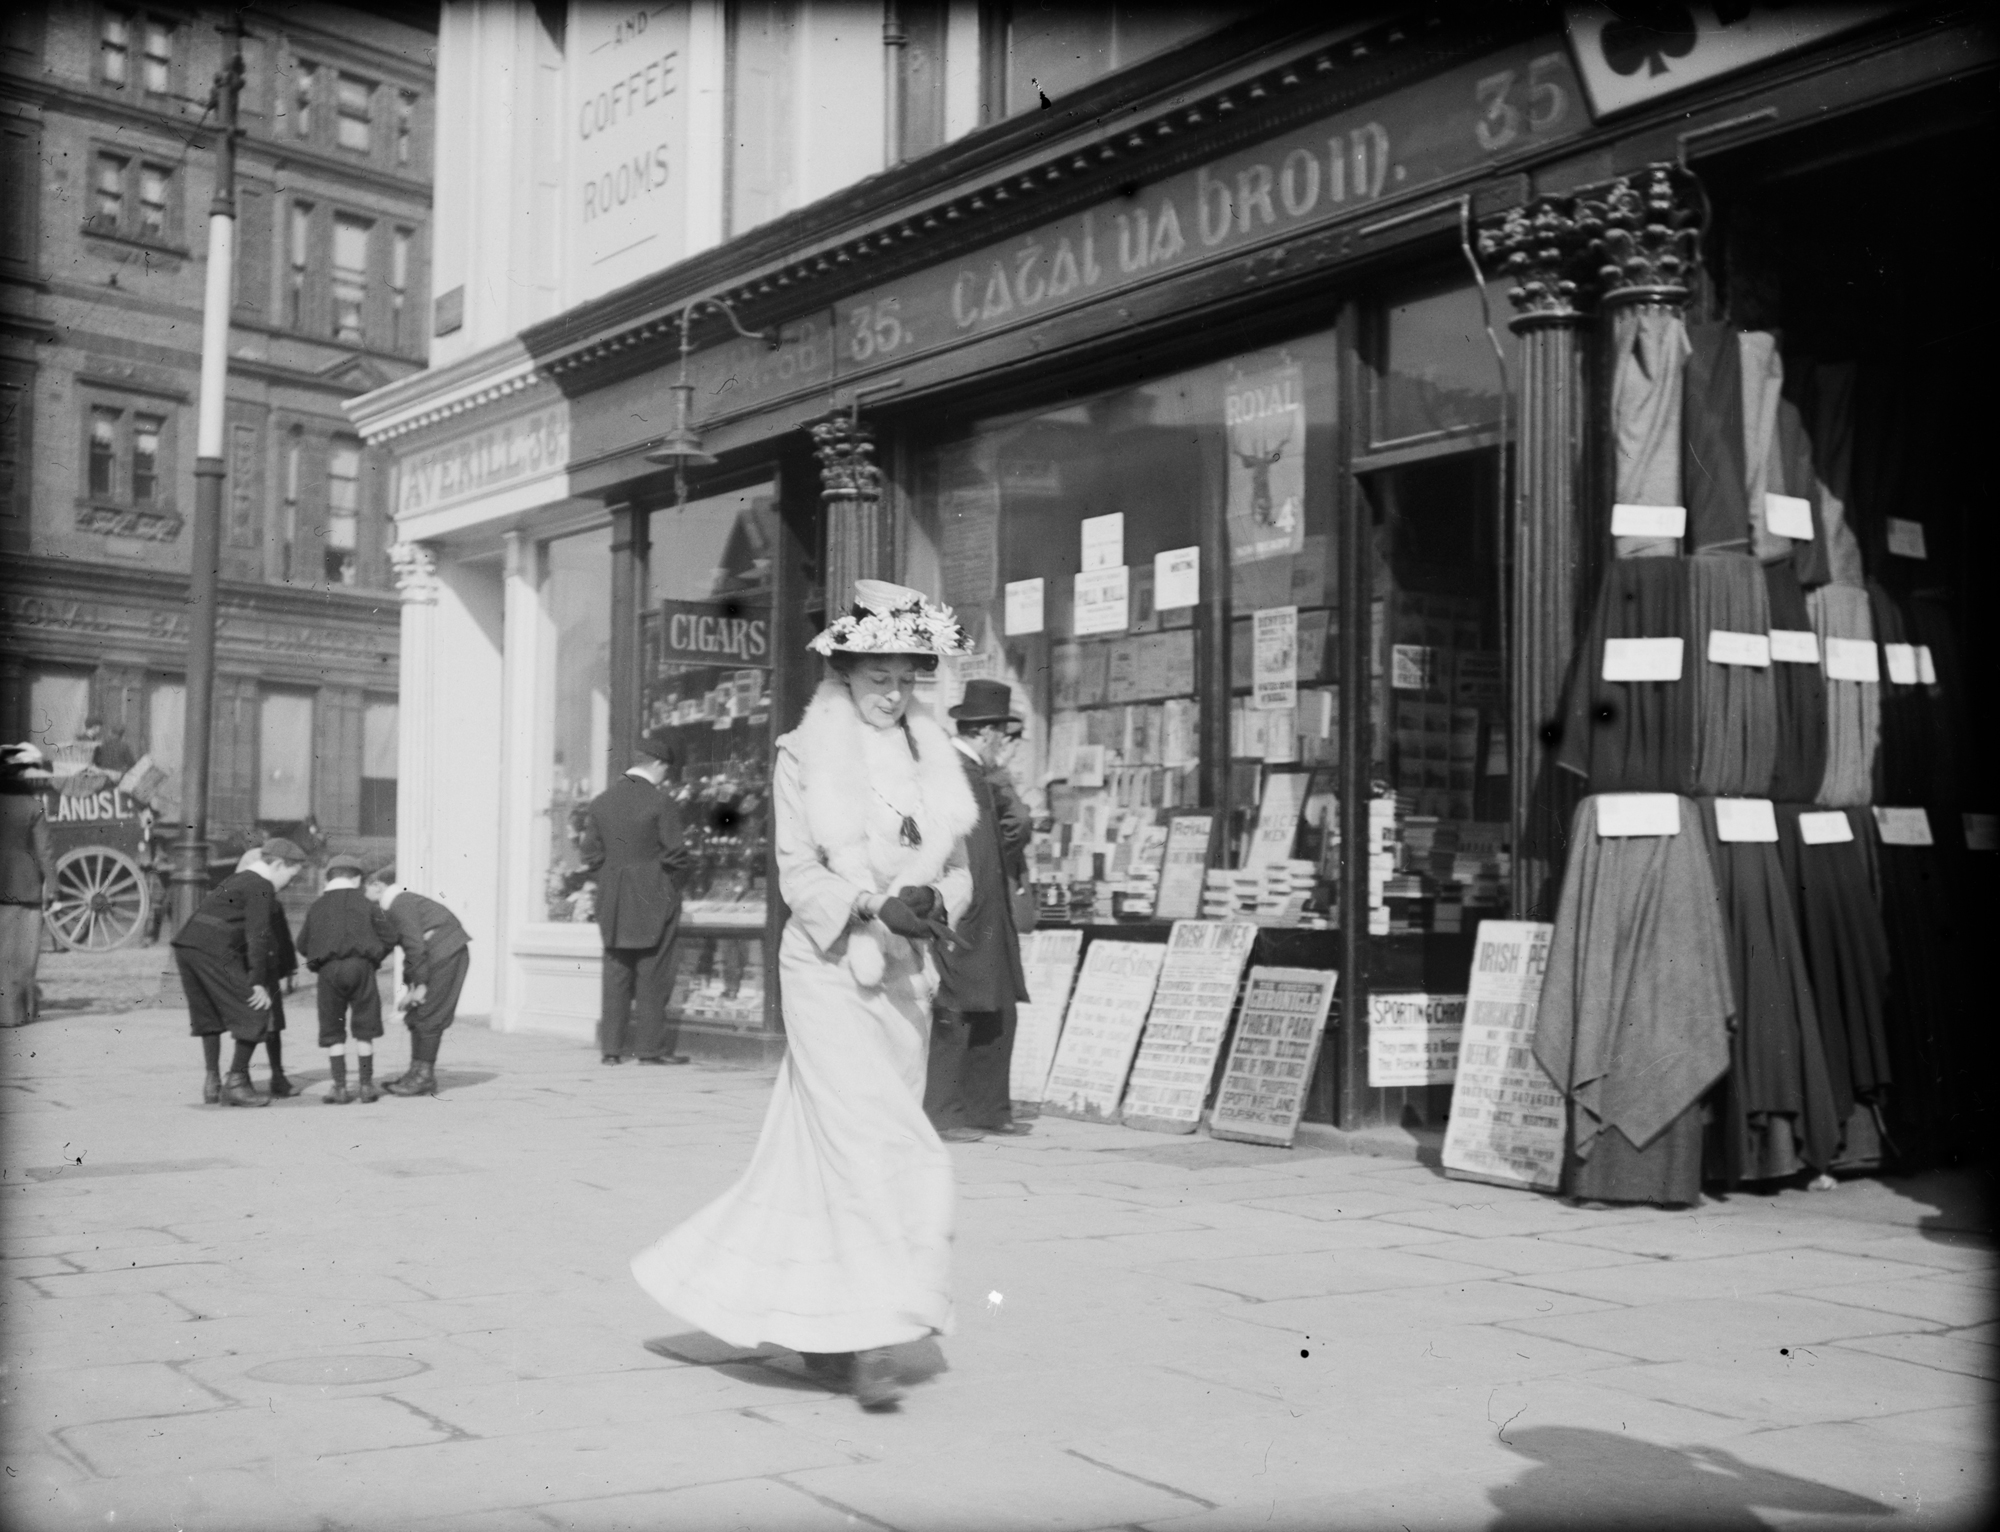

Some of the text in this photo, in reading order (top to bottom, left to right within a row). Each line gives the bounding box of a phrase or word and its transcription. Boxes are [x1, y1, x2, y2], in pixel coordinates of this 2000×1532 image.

[579, 50, 679, 141] COFFEE
[1474, 53, 1568, 153] 35
[583, 143, 669, 224] ROOMS
[850, 297, 914, 361] 35.
[1226, 380, 1299, 427] ROYAL
[669, 612, 766, 660] CIGARS
[1478, 942, 1549, 976] IRISH PE
[1525, 930, 1547, 943] THE
[1373, 1000, 1432, 1025] SPORTING
[1433, 1001, 1468, 1025] CHRO
[1219, 1106, 1267, 1121] COURSING
[1221, 1090, 1254, 1106] SPORT
[1257, 1095, 1297, 1112] IRELAND
